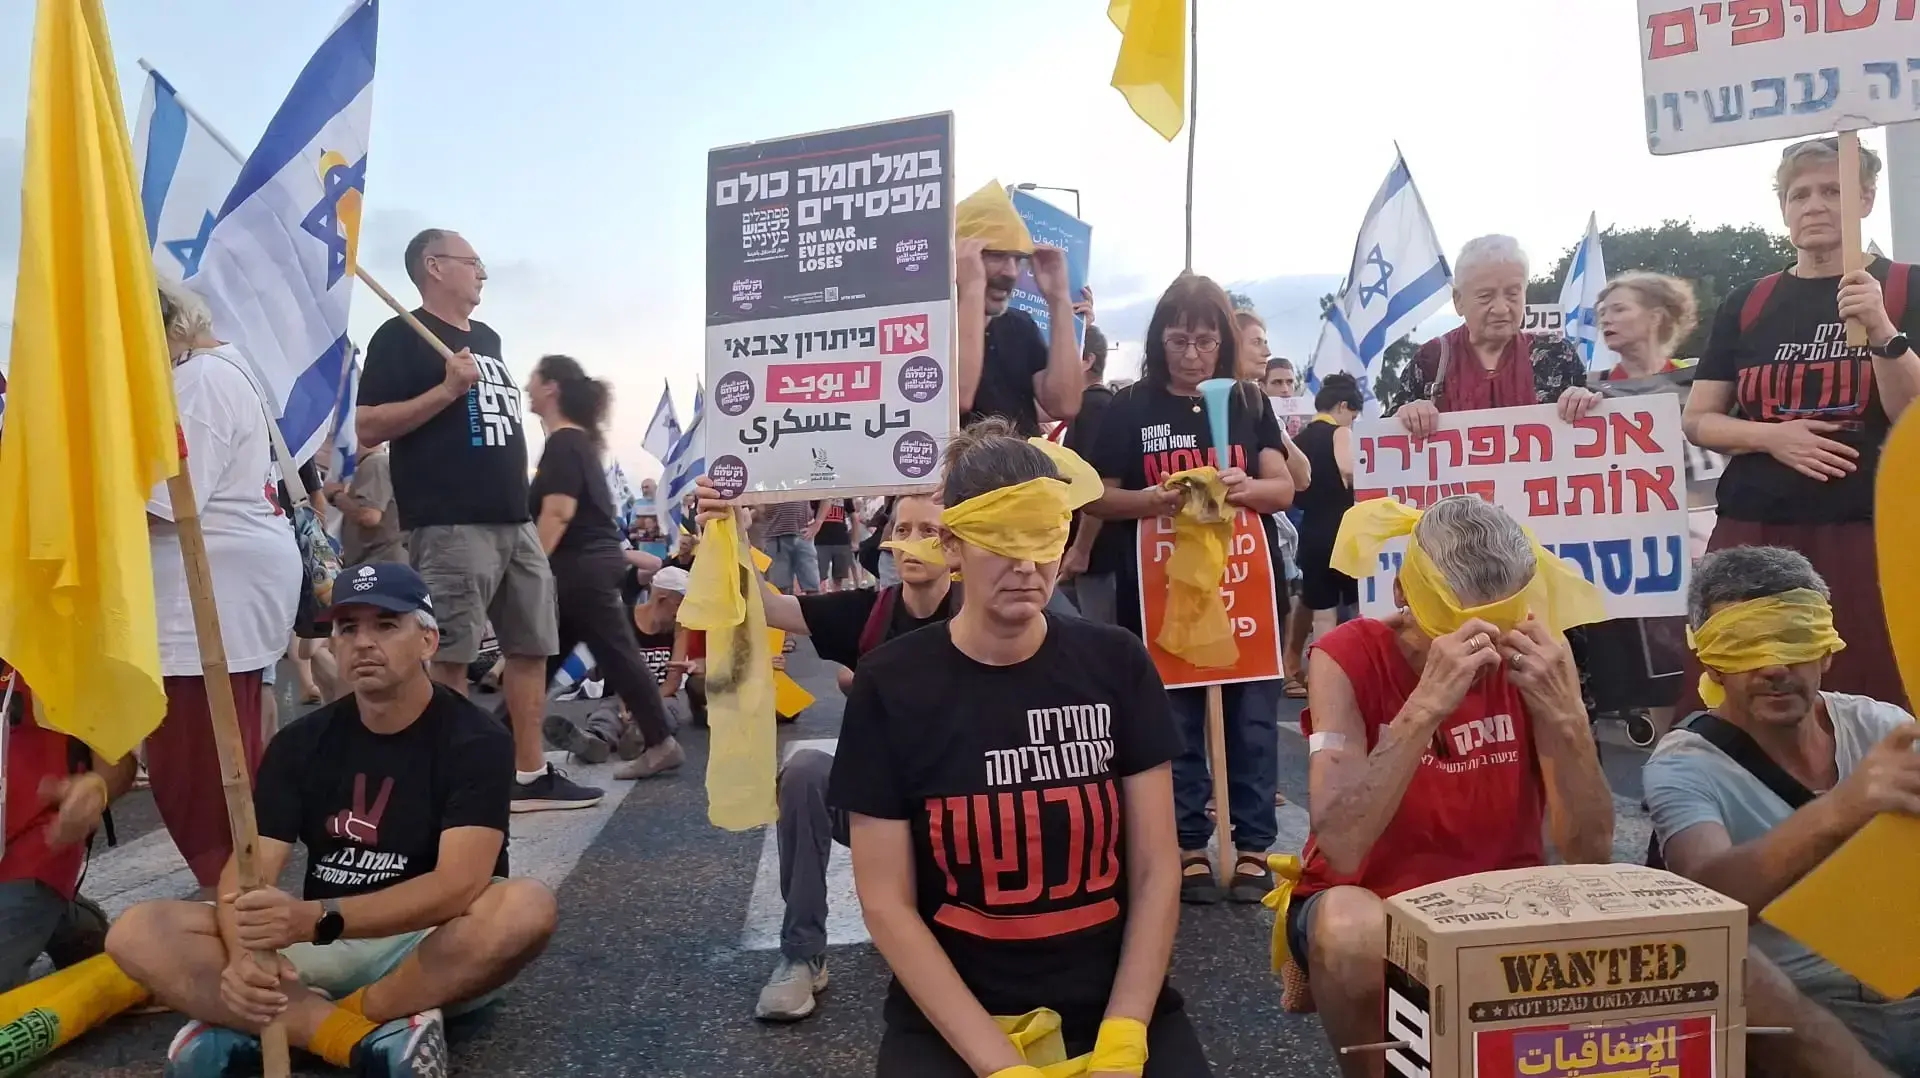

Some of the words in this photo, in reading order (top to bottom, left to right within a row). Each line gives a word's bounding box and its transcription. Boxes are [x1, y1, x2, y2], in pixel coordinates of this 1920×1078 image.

[797, 149, 942, 194] במלחמה
[716, 170, 789, 206] כולם
[798, 181, 941, 226] מפסידים
[743, 218, 789, 235] לכיבוש
[798, 231, 817, 245] IN
[820, 226, 856, 241] WAR
[799, 237, 877, 259] EVERYONE
[799, 256, 843, 273] LOSES
[1520, 306, 1561, 329] כול
[724, 333, 789, 358] צבאי
[795, 327, 876, 359] פיתרון
[884, 322, 925, 351] אין
[1774, 343, 1828, 361] הביתה
[779, 370, 845, 400] يوجد
[852, 365, 871, 389] لا
[739, 408, 852, 453] عسكري
[864, 403, 911, 438] حل
[1141, 423, 1171, 442] BRING
[1142, 437, 1168, 453] THEM
[1169, 434, 1198, 449] HOME
[1360, 423, 1554, 481] תפקירו
[1523, 464, 1680, 517] אותם
[984, 745, 1060, 786] הביתה
[1060, 740, 1115, 779] אותם
[924, 779, 1119, 905] עכשיו
[1500, 941, 1687, 995] WANTED
[1507, 1001, 1541, 1018] NOT
[1547, 998, 1588, 1016] DEAD
[1592, 992, 1636, 1011] ONLY
[1637, 987, 1684, 1006] ALIVE
